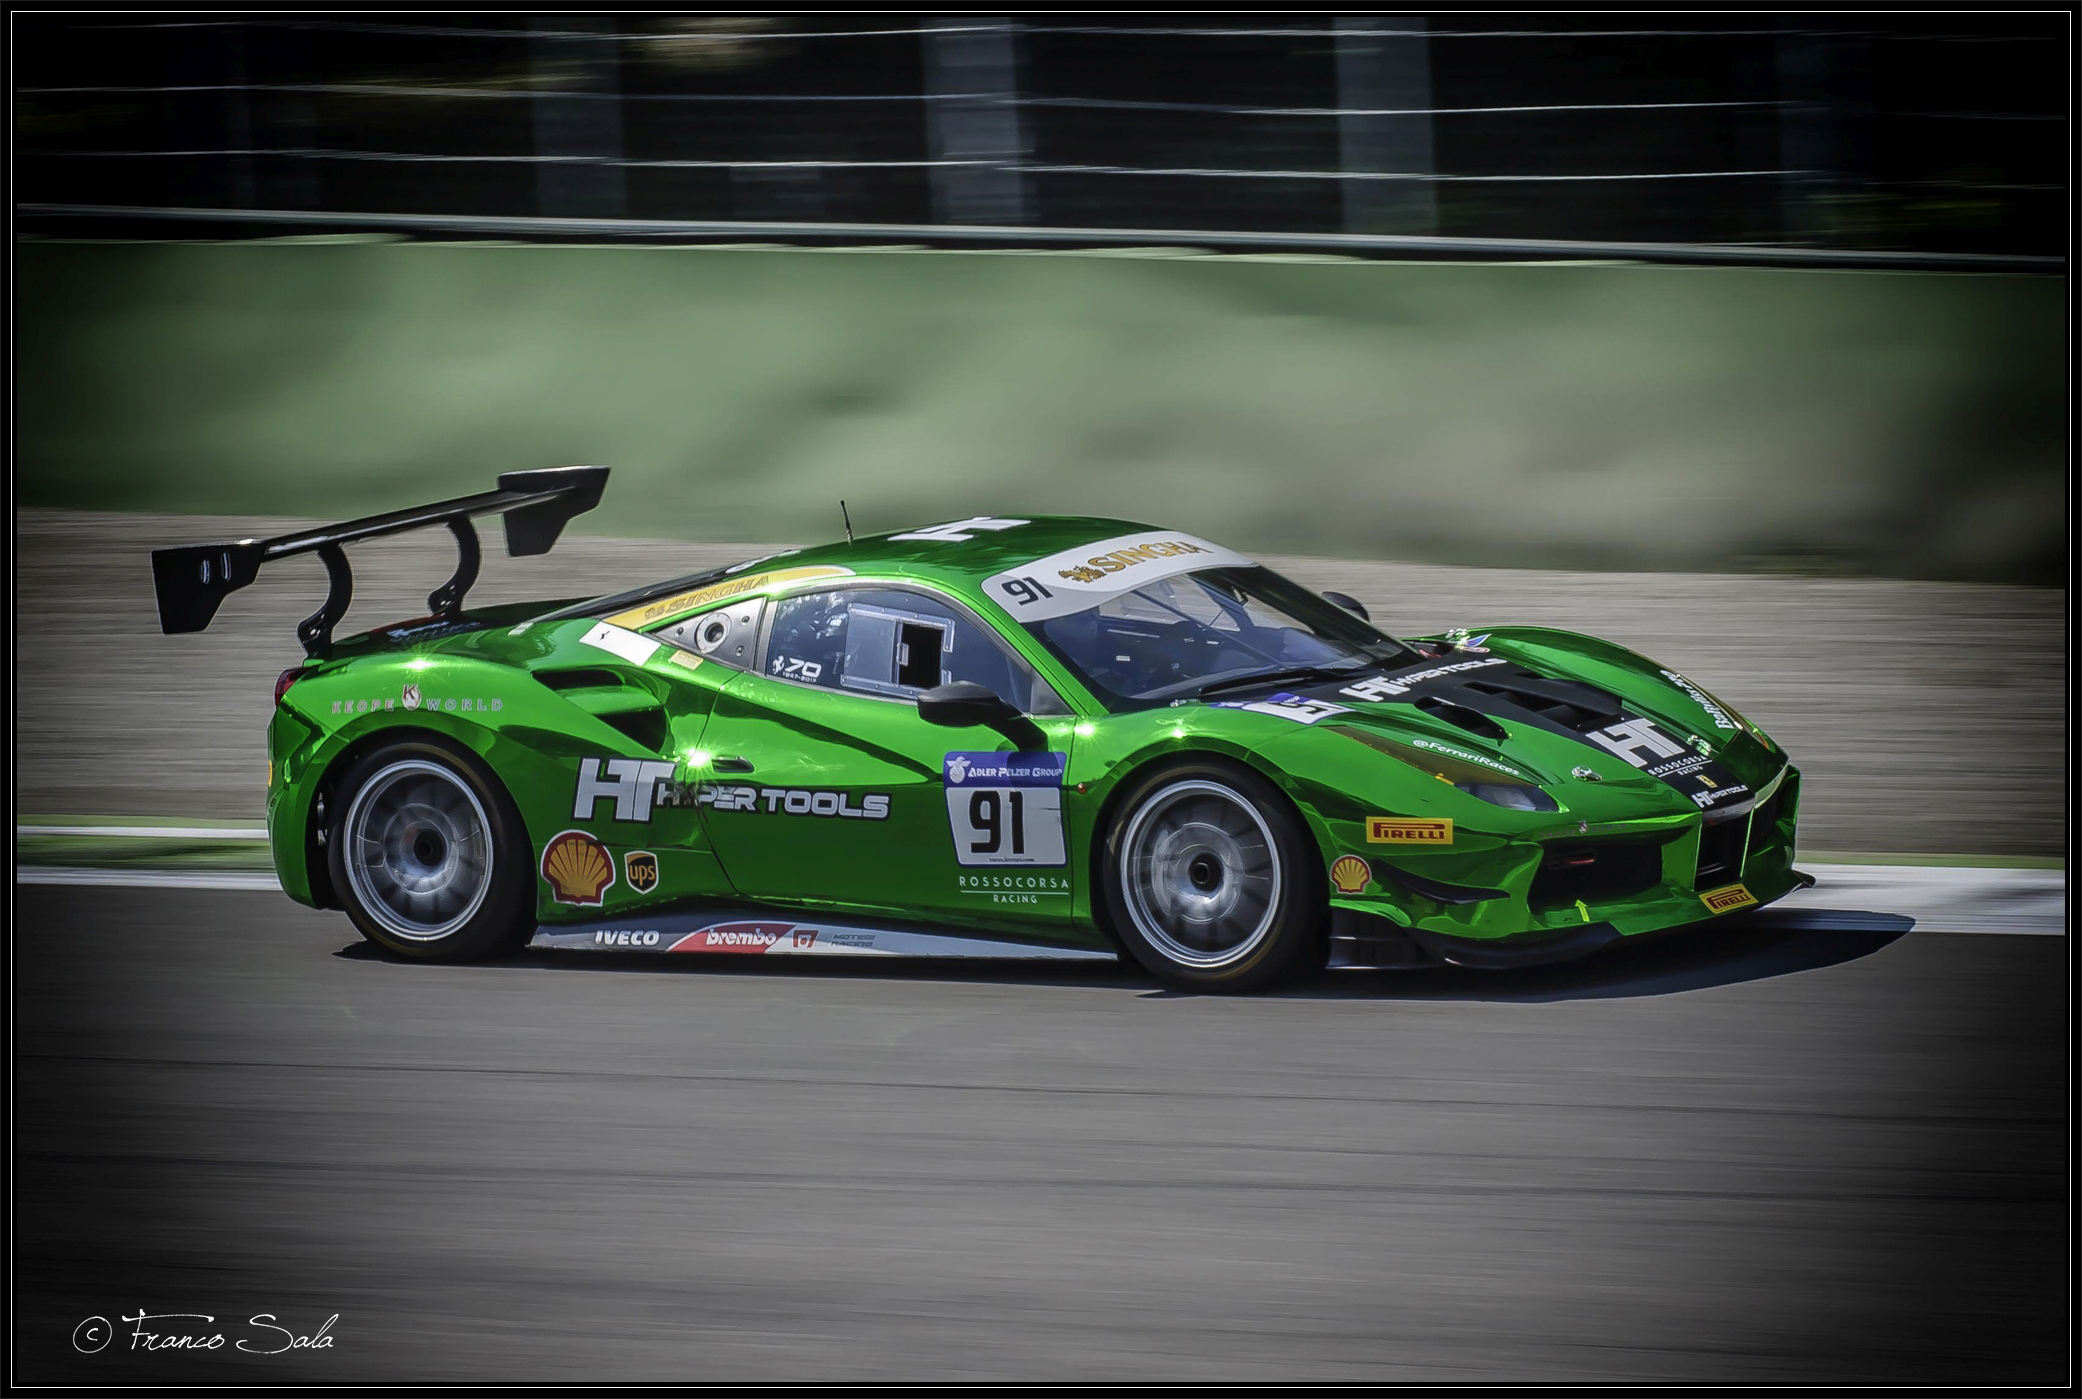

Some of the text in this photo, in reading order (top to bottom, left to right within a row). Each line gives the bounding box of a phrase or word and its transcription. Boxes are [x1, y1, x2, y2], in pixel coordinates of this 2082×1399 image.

[1087, 540, 1214, 573] SINGHA
[666, 575, 769, 614] SINGHA
[1001, 576, 1054, 606] 91
[784, 657, 822, 678] 70
[1339, 675, 1410, 702] HT
[332, 698, 395, 714] KEOPE
[426, 698, 504, 711] WORLD
[1585, 717, 1686, 768] HT
[1412, 739, 1520, 776] @FerrariRaces
[1647, 755, 1708, 776] ROSSOCORSA
[967, 767, 997, 778] ADLER
[1677, 765, 1704, 776] RACING
[574, 758, 676, 822] HT
[761, 788, 890, 818] TOOLS
[1691, 790, 1715, 809] HT
[969, 790, 1025, 855] 91
[1372, 822, 1446, 840] PIRELLI
[629, 864, 656, 886] ups
[959, 875, 1069, 888] ROSSOCORSA
[993, 894, 1038, 904] RACING
[1706, 888, 1752, 910] PIRELLI
[595, 930, 660, 946] IVECO
[706, 928, 776, 946] brembo
